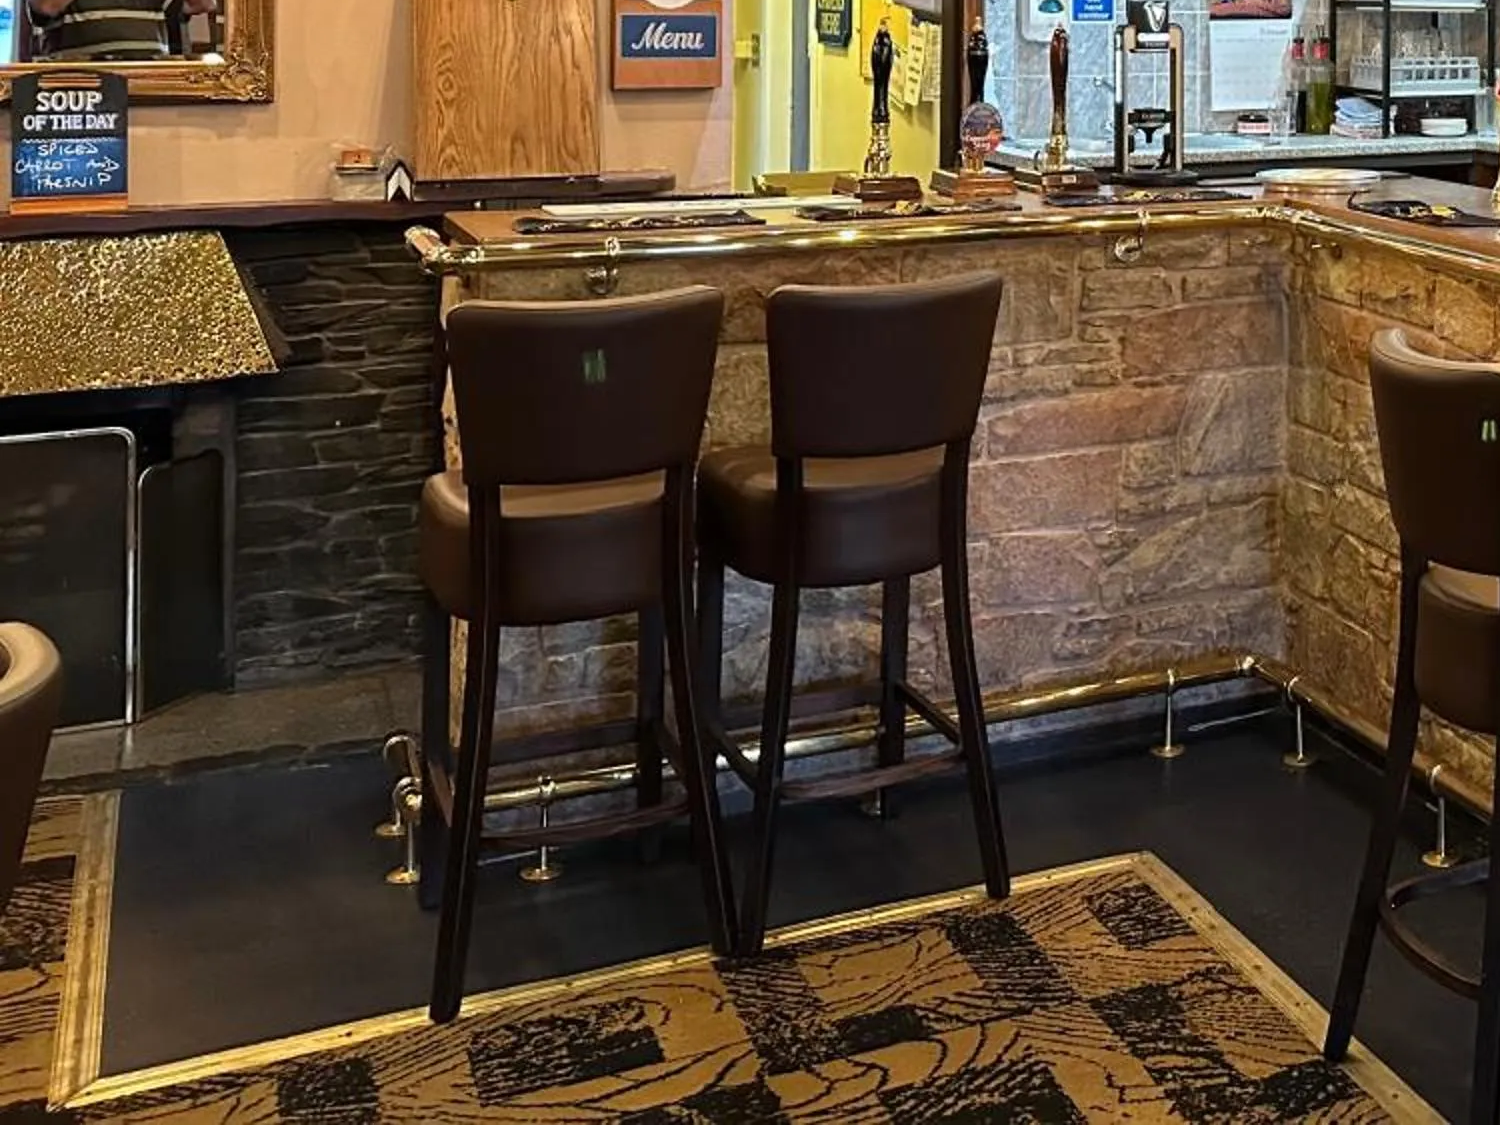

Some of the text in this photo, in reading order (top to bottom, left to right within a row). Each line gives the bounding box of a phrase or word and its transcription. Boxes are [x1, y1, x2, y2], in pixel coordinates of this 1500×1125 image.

[631, 21, 705, 50] Menu
[36, 90, 102, 112] SOUP
[23, 113, 119, 131] OF THE DAY
